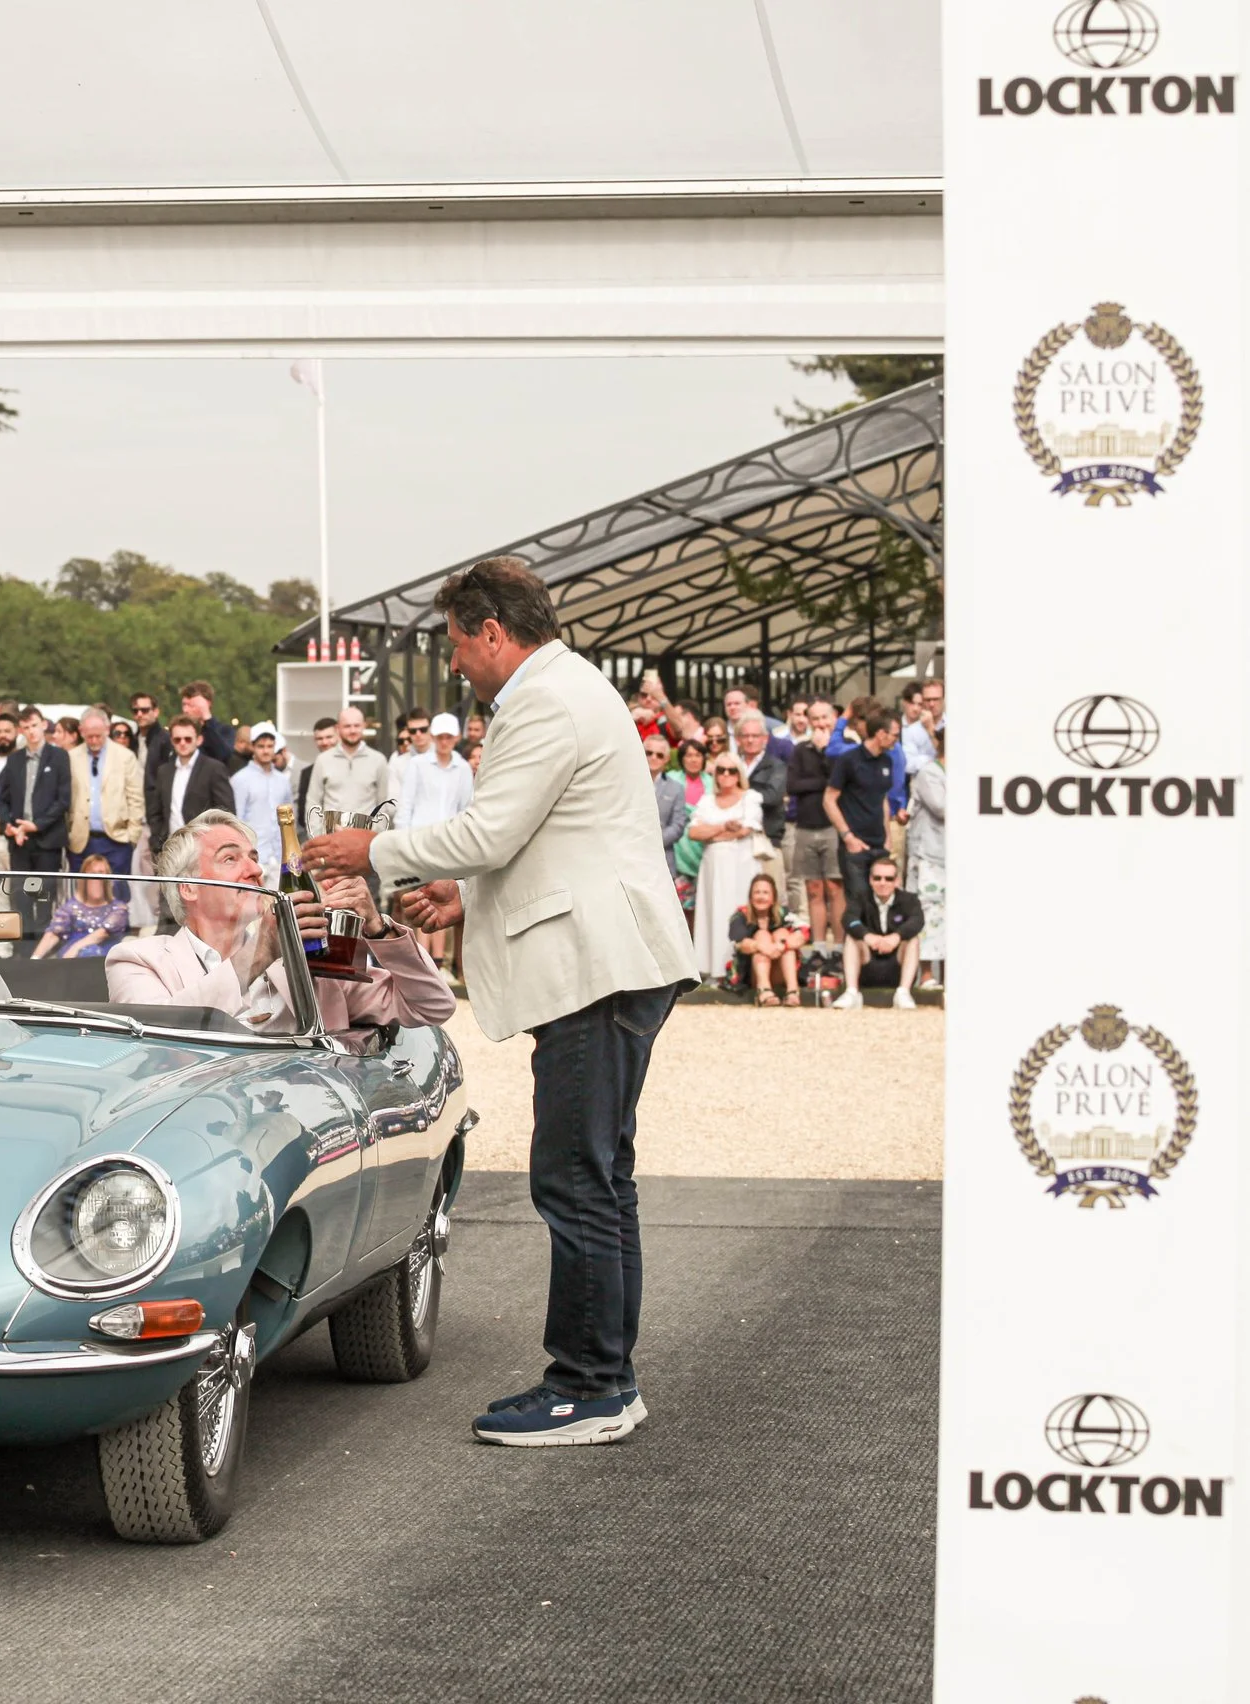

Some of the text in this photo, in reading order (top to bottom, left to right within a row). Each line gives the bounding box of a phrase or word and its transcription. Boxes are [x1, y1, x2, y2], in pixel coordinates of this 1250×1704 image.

[978, 75, 1236, 117] LOCKTON
[1059, 360, 1157, 387] SALON
[1060, 383, 1156, 414] PRIVÉ
[978, 775, 1235, 817] LOCKTON
[1055, 1062, 1152, 1088] SALON
[1055, 1085, 1151, 1116] PRIVÉ
[968, 1471, 1224, 1517] LOCKTON
